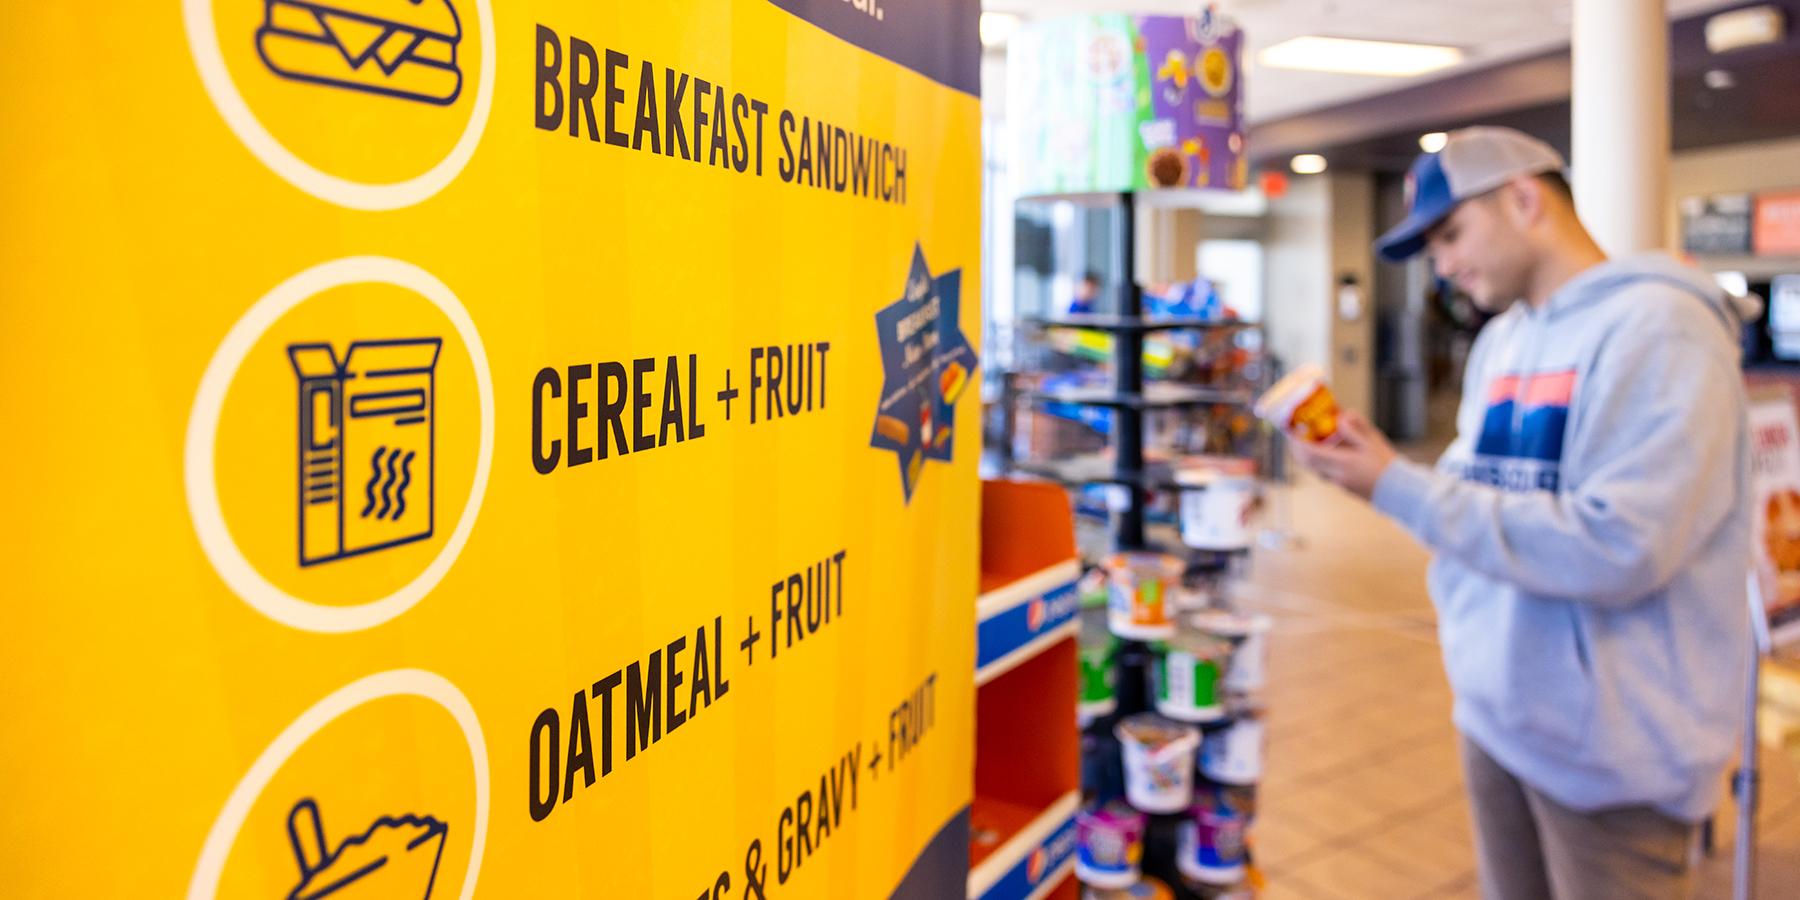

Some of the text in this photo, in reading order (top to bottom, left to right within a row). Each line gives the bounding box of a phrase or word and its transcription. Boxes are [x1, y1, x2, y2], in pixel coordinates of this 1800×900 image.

[535, 23, 907, 205] BREAKFAST SANDWICH
[532, 353, 705, 475] CEREAL
[717, 369, 738, 421] +
[750, 341, 830, 425] FRUIT
[529, 549, 846, 822] OATMEAL + FRUIT
[778, 741, 861, 885] GRAVY
[888, 672, 937, 773] FRUIT
